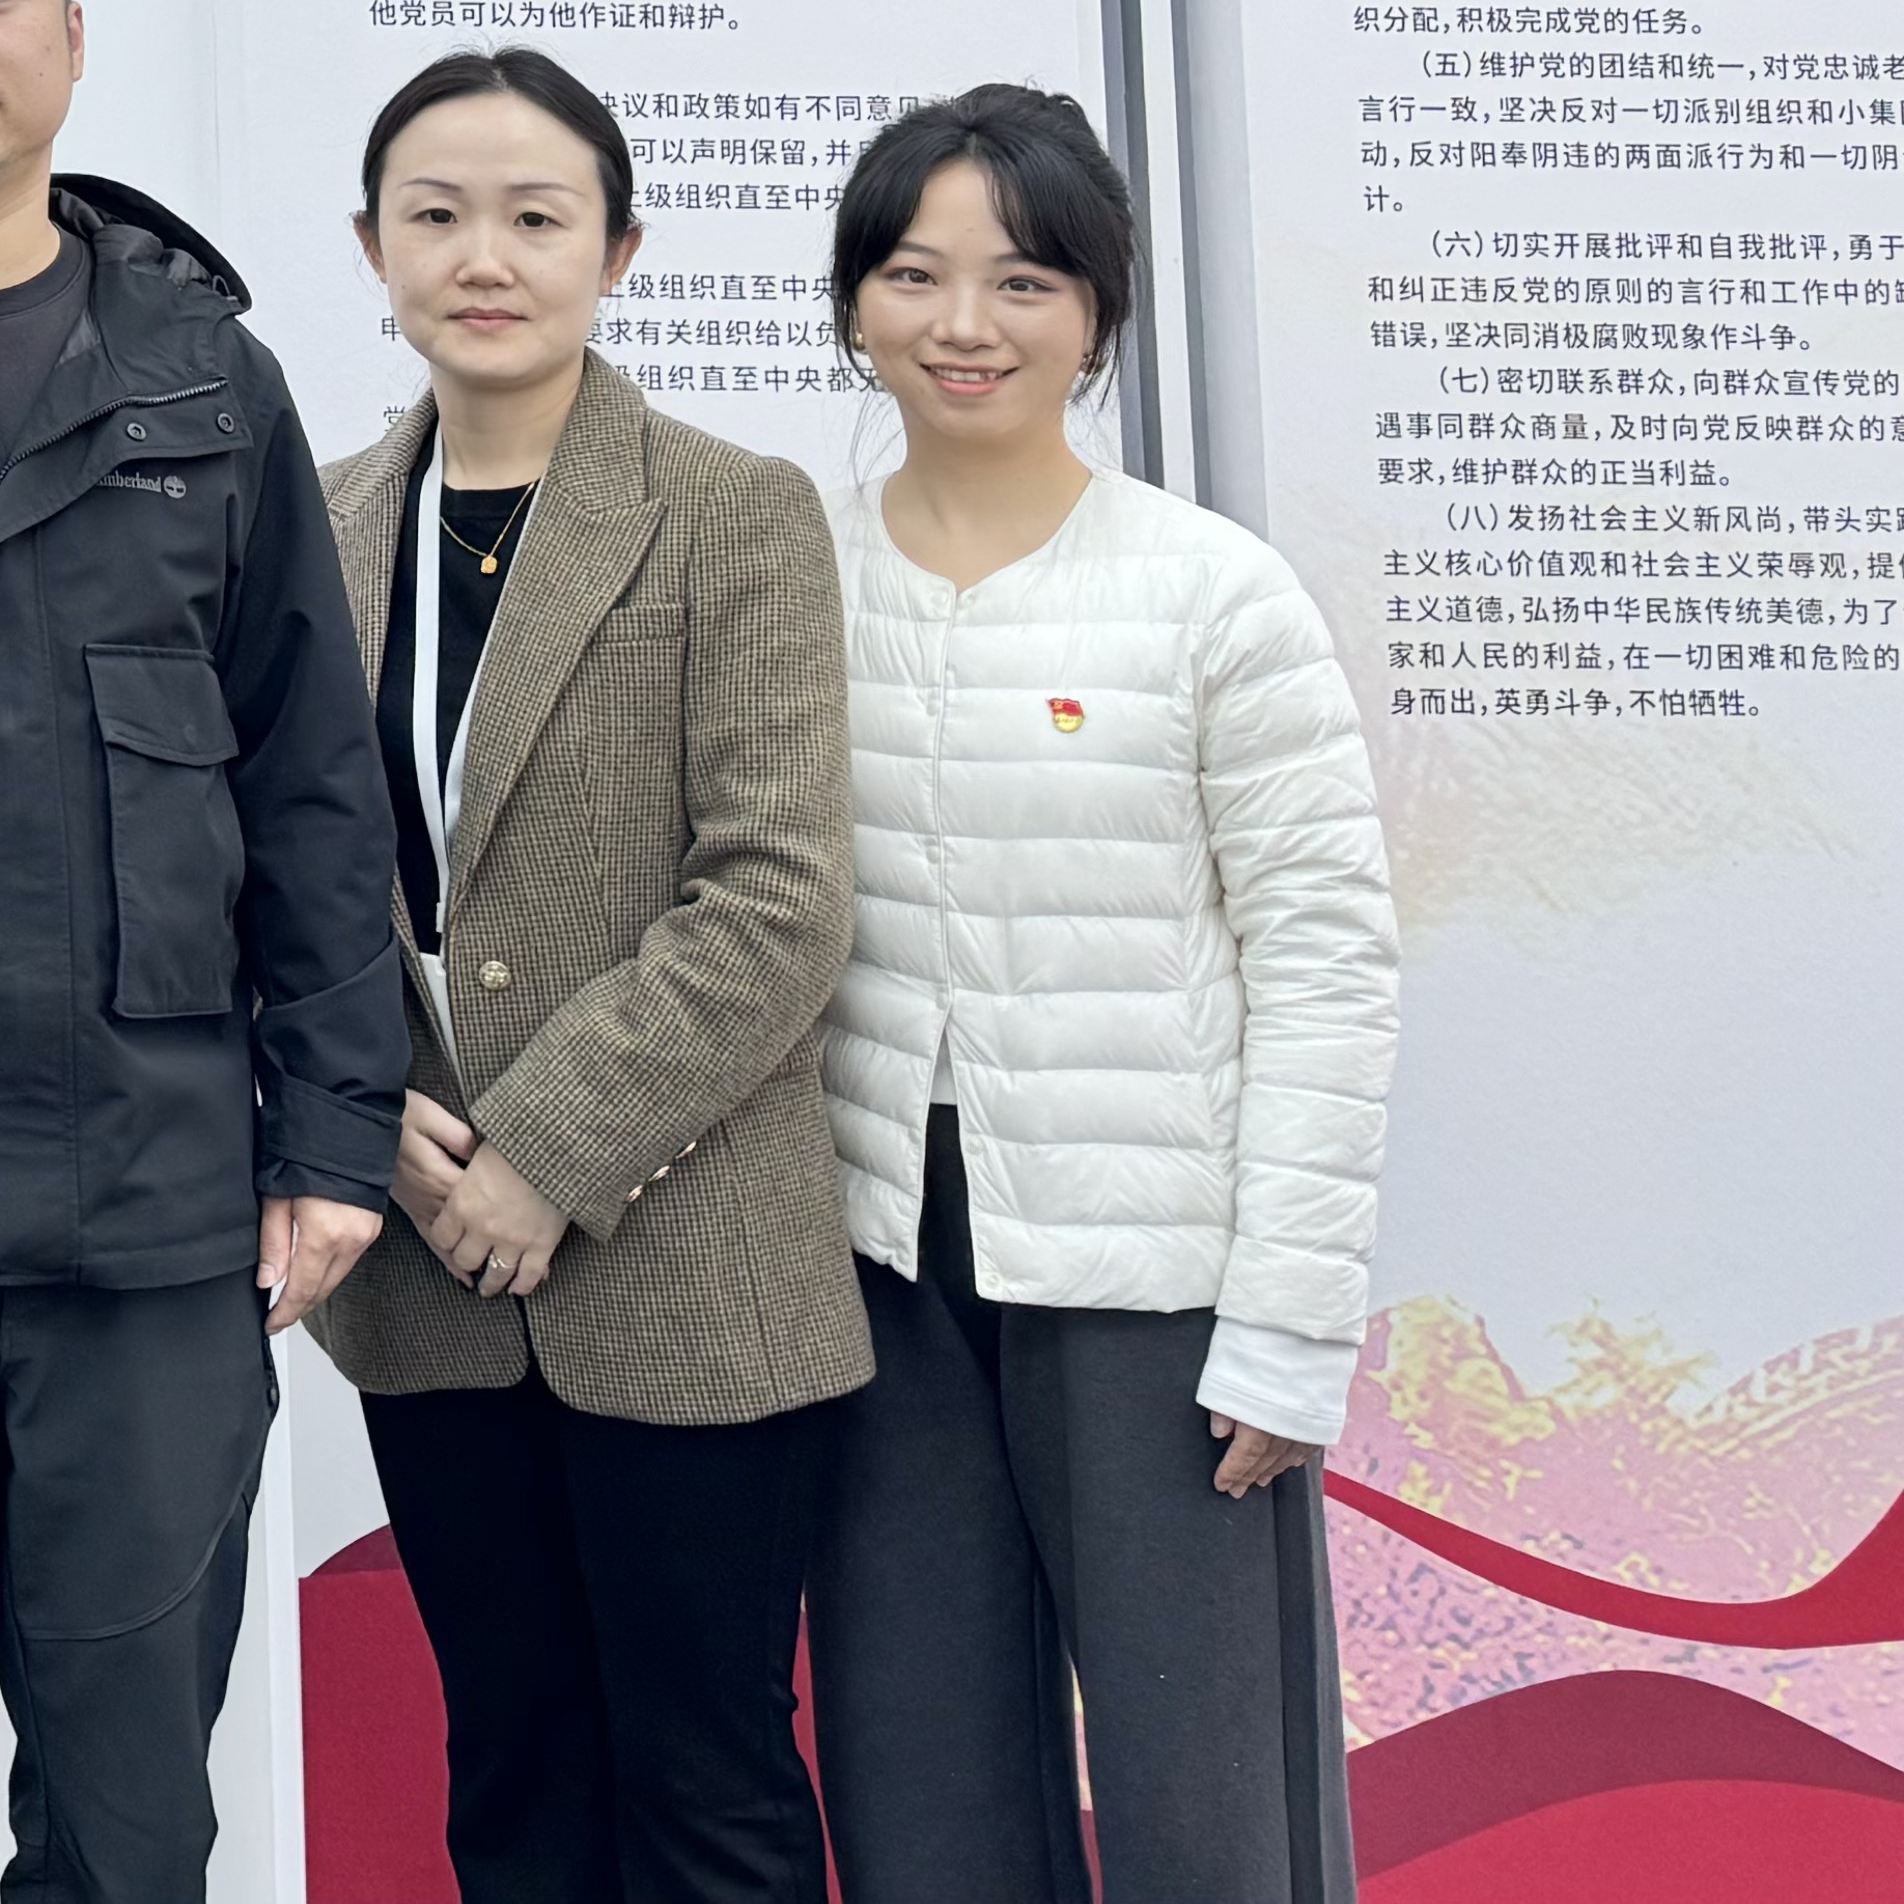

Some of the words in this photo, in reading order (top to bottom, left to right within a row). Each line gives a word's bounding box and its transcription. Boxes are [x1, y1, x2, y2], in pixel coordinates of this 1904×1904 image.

[369, 0, 738, 30] 他党员可以为他作证和辩护。
[1353, 6, 1701, 35] 织分配，积极完成党的任务。
[1358, 95, 1904, 126] 言行一致，坚决反对一切派别组织和小集
[1361, 140, 1904, 170] 动，反对阳奉阴违的两面派行为和一切阴
[1363, 185, 1403, 213] 计。
[1370, 320, 1810, 351] 错误，坚决同消极腐败现象作斗争。
[1440, 366, 1899, 396] （七）密切联系群众，向群众宣传党的
[1378, 457, 1729, 487] 要求，维护群众的正当利益。
[1384, 549, 1904, 580] 主义核心价值观和社会主义荣辱观，提
[1386, 595, 1904, 626] 主义道德，弘扬中华民族传统美德，为了
[1388, 641, 1899, 671] 家和人民的利益，在一切困难和危险的
[1391, 687, 1759, 717] 身而出，英勇斗争，不怕牺牲。
